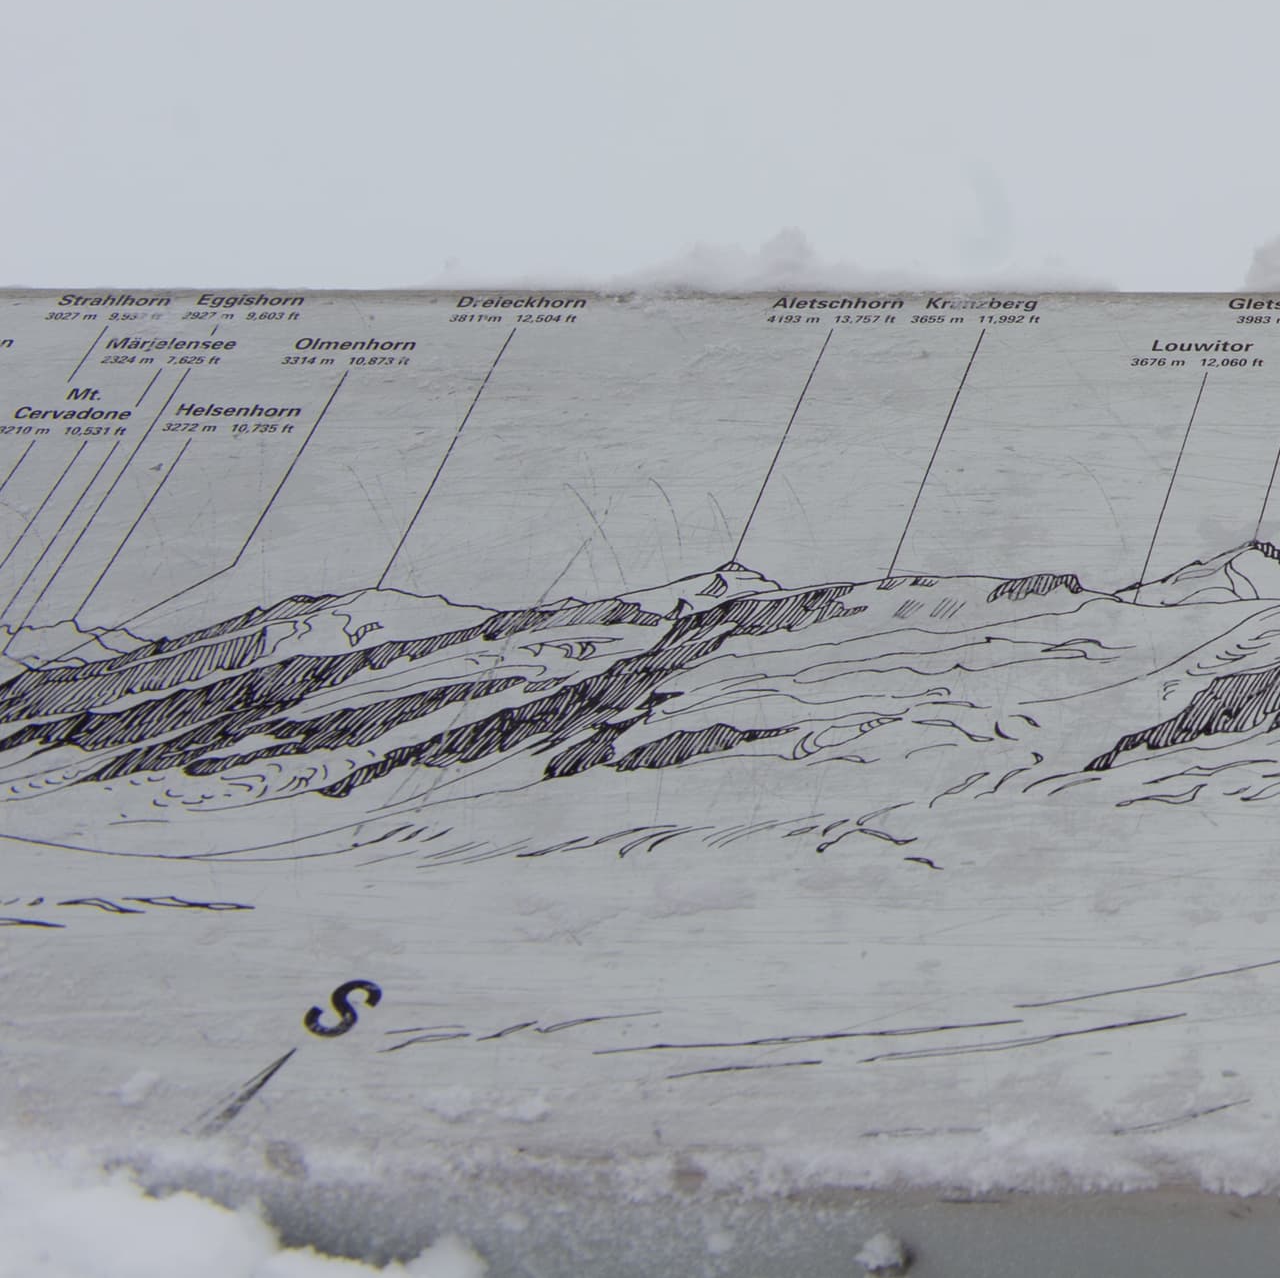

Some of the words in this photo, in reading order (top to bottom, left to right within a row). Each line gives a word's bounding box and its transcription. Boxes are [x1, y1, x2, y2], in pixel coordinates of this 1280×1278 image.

[58, 294, 171, 307] Strahlhorn
[197, 293, 304, 308] Eggishorn
[772, 297, 904, 309] Aletschhorn
[45, 312, 80, 320] 3027
[246, 312, 285, 321] 9,603
[288, 312, 299, 320] ft
[517, 314, 561, 323] 12,504
[565, 314, 576, 322] ft
[835, 315, 880, 324] 13,757
[884, 315, 896, 323] ft
[911, 315, 945, 323] 3655
[980, 315, 1024, 324] 11,992
[1029, 315, 1040, 323] ft
[1236, 316, 1271, 324] 3983
[105, 337, 237, 352] Märjelensee
[294, 338, 416, 350] Olmenhorn
[1152, 340, 1254, 352] Louwitor
[167, 356, 204, 365] 7,625
[281, 357, 316, 365] 3314
[349, 357, 393, 366] 10,873
[398, 357, 409, 365] ft
[1131, 358, 1166, 367] 3676
[1200, 358, 1247, 368] 12,060
[1252, 358, 1263, 367] ft
[66, 388, 101, 400] Mt.
[14, 406, 132, 420] Cervadone
[175, 404, 301, 417] Helsenhorn
[0, 426, 32, 434] 3210
[64, 426, 110, 436] 10,531
[114, 426, 126, 435] ft
[162, 424, 198, 432] 3272
[232, 424, 276, 434] 10,735
[281, 424, 294, 433] ft
[304, 979, 382, 1038] S
